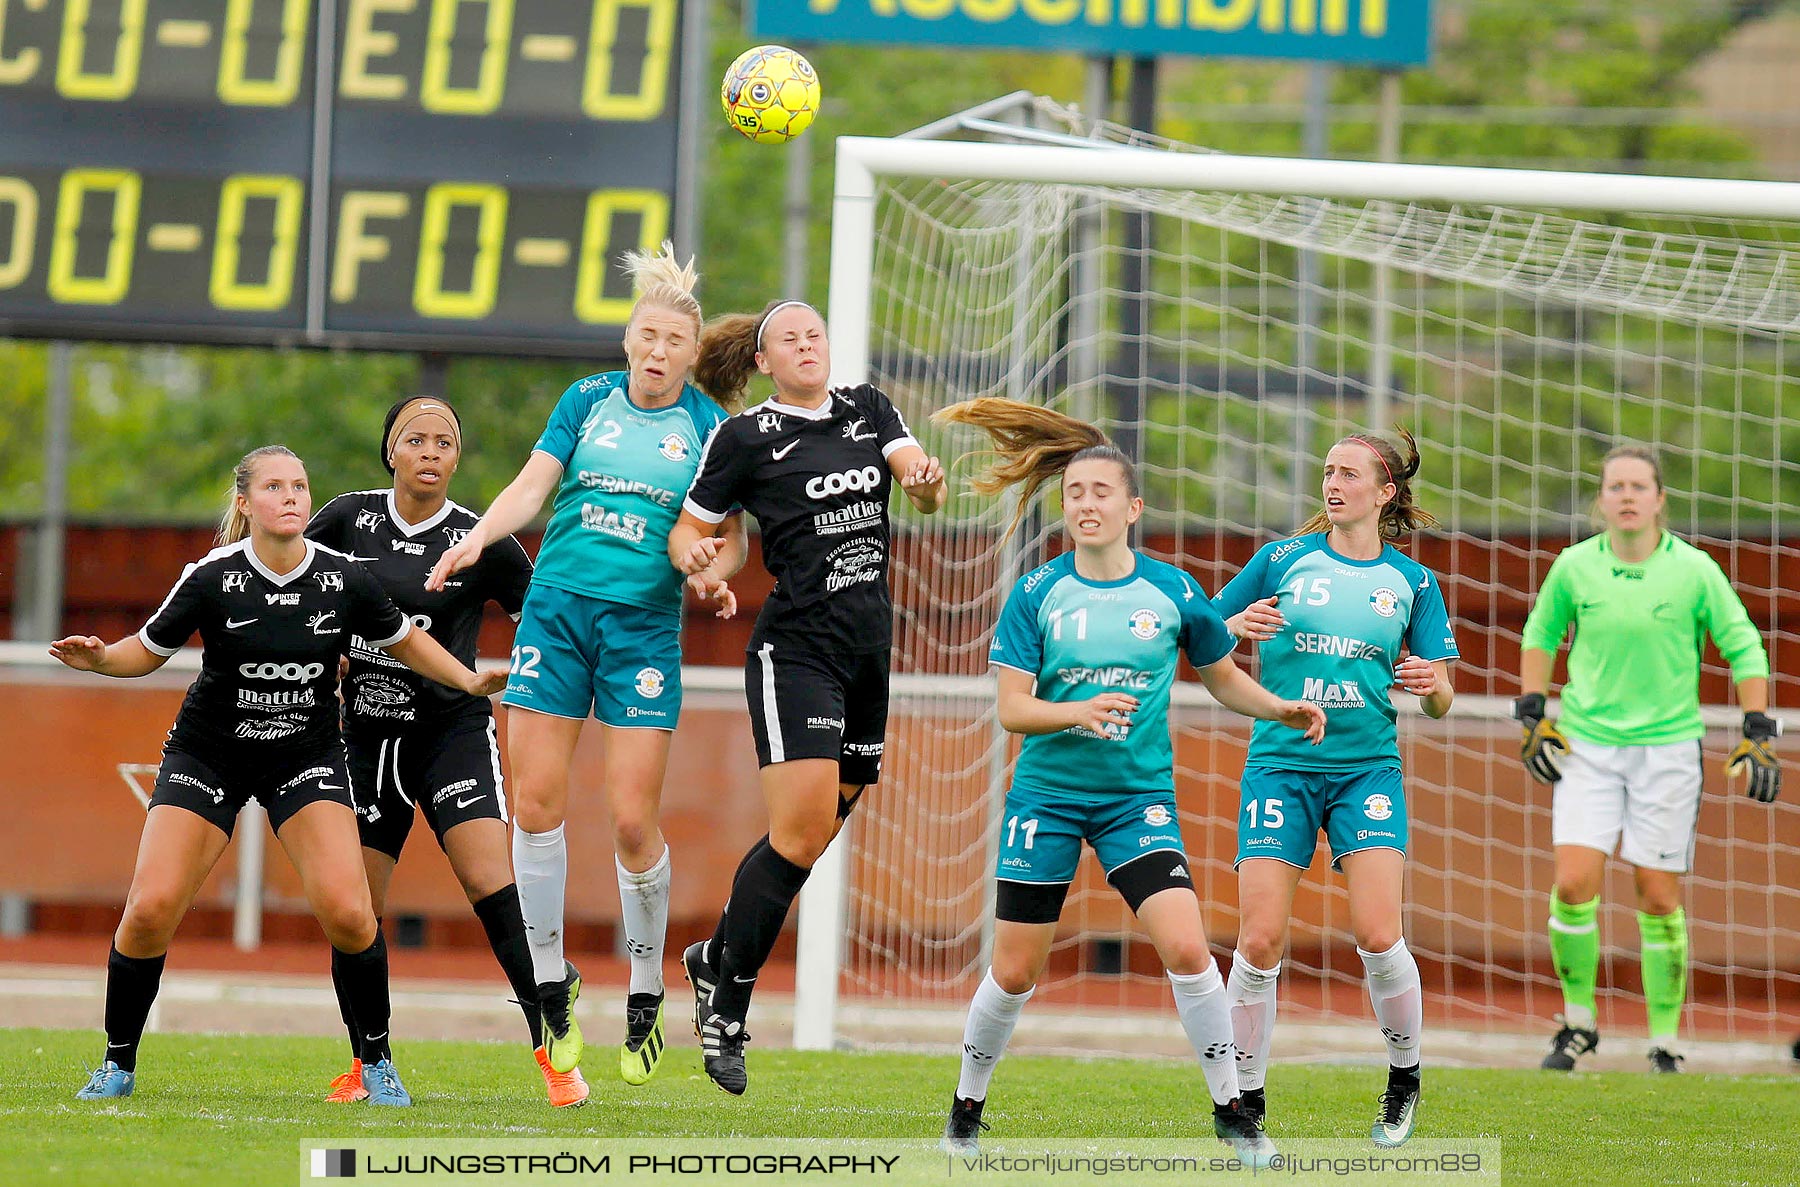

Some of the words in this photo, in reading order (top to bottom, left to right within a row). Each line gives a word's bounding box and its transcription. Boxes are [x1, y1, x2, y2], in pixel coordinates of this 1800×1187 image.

[339, 0, 408, 98] E
[331, 191, 410, 303] F
[578, 470, 677, 507] SERNEKE
[805, 465, 881, 499] coop
[581, 502, 647, 538] MAXI
[814, 500, 883, 526] mattias
[1270, 539, 1305, 562] adact
[1290, 577, 1332, 606] 15
[1049, 607, 1088, 641] 11
[510, 644, 542, 679] 12
[1294, 632, 1384, 661] SERNEKE
[239, 663, 324, 684] coop
[1057, 666, 1152, 688] SERNEKE
[1301, 677, 1365, 701] MAXI
[638, 708, 666, 717] Electrolux
[1245, 798, 1285, 829] 15
[1007, 815, 1038, 850] 11
